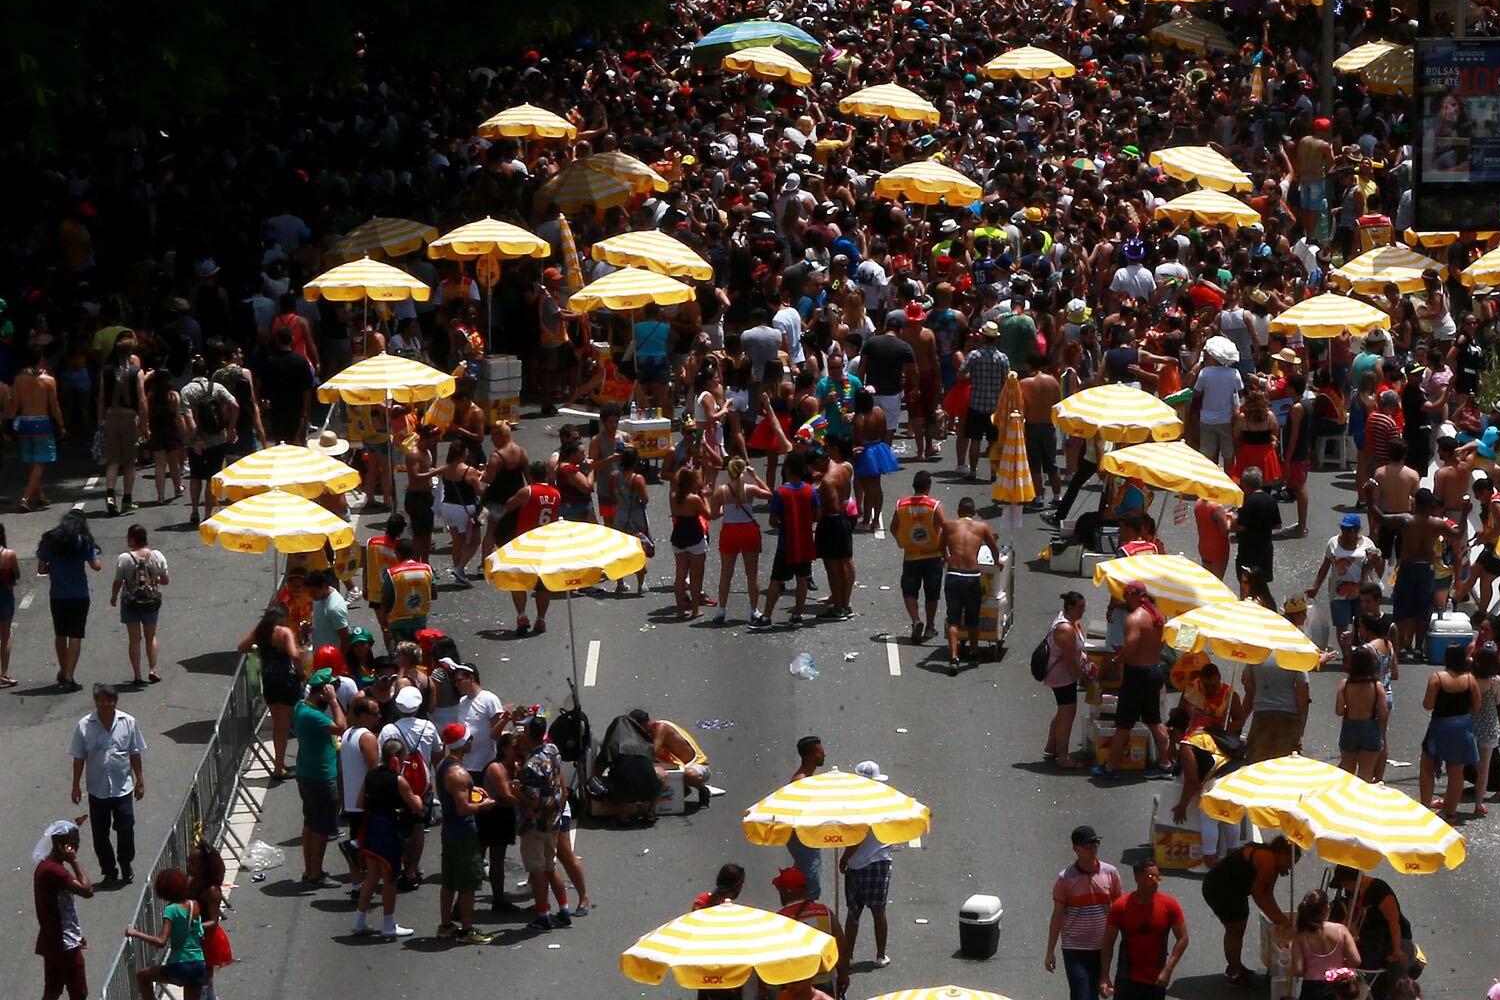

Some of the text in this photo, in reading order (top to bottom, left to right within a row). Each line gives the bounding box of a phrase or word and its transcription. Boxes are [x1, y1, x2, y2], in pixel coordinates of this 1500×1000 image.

[1425, 66, 1460, 76] BOLSAS
[1431, 76, 1460, 86] DE ATÉ
[975, 269, 985, 283] 15
[538, 508, 553, 525] 6
[702, 976, 723, 984] SKOL
